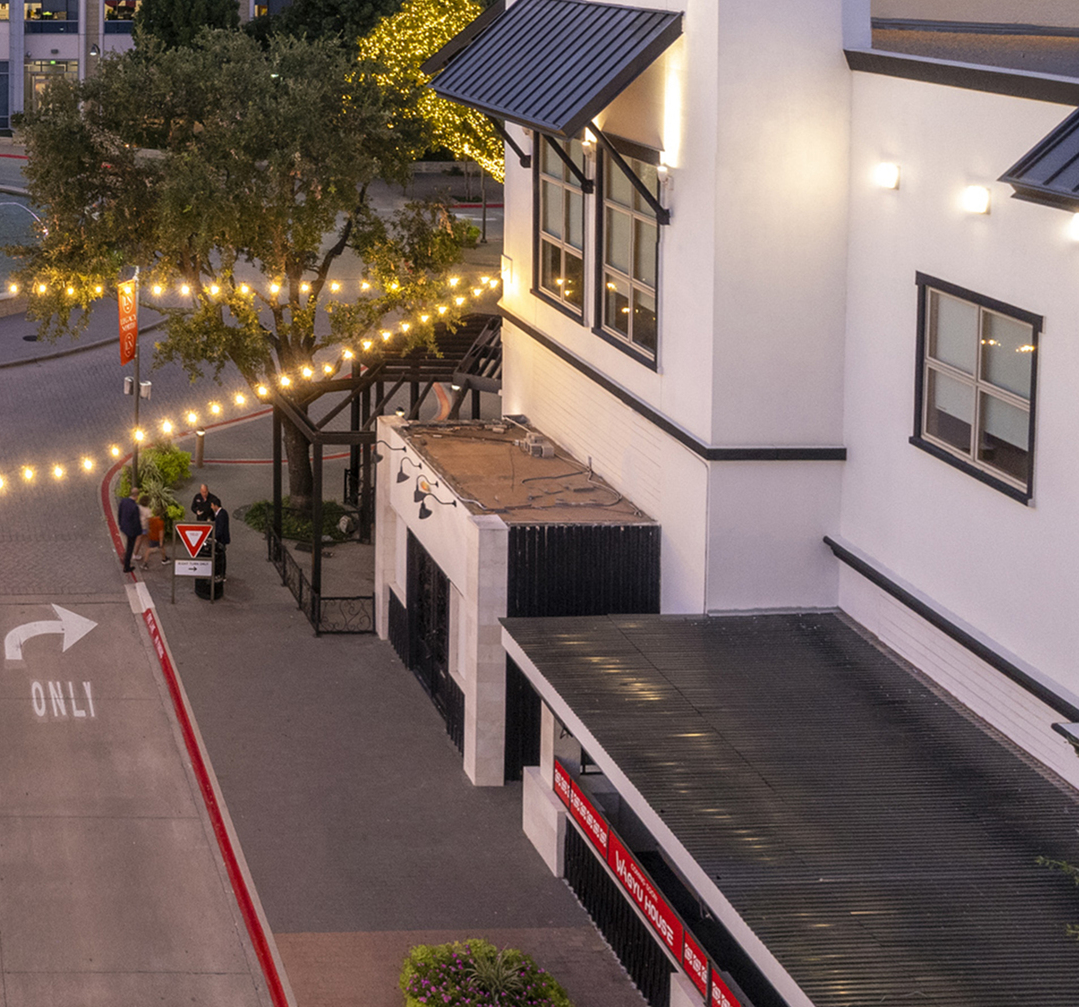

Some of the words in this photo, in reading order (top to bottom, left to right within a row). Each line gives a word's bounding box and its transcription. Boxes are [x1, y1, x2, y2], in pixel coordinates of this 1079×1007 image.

[31, 681, 95, 717] ONLY
[615, 850, 644, 902] WAGYU
[645, 895, 674, 946] HOUSE
